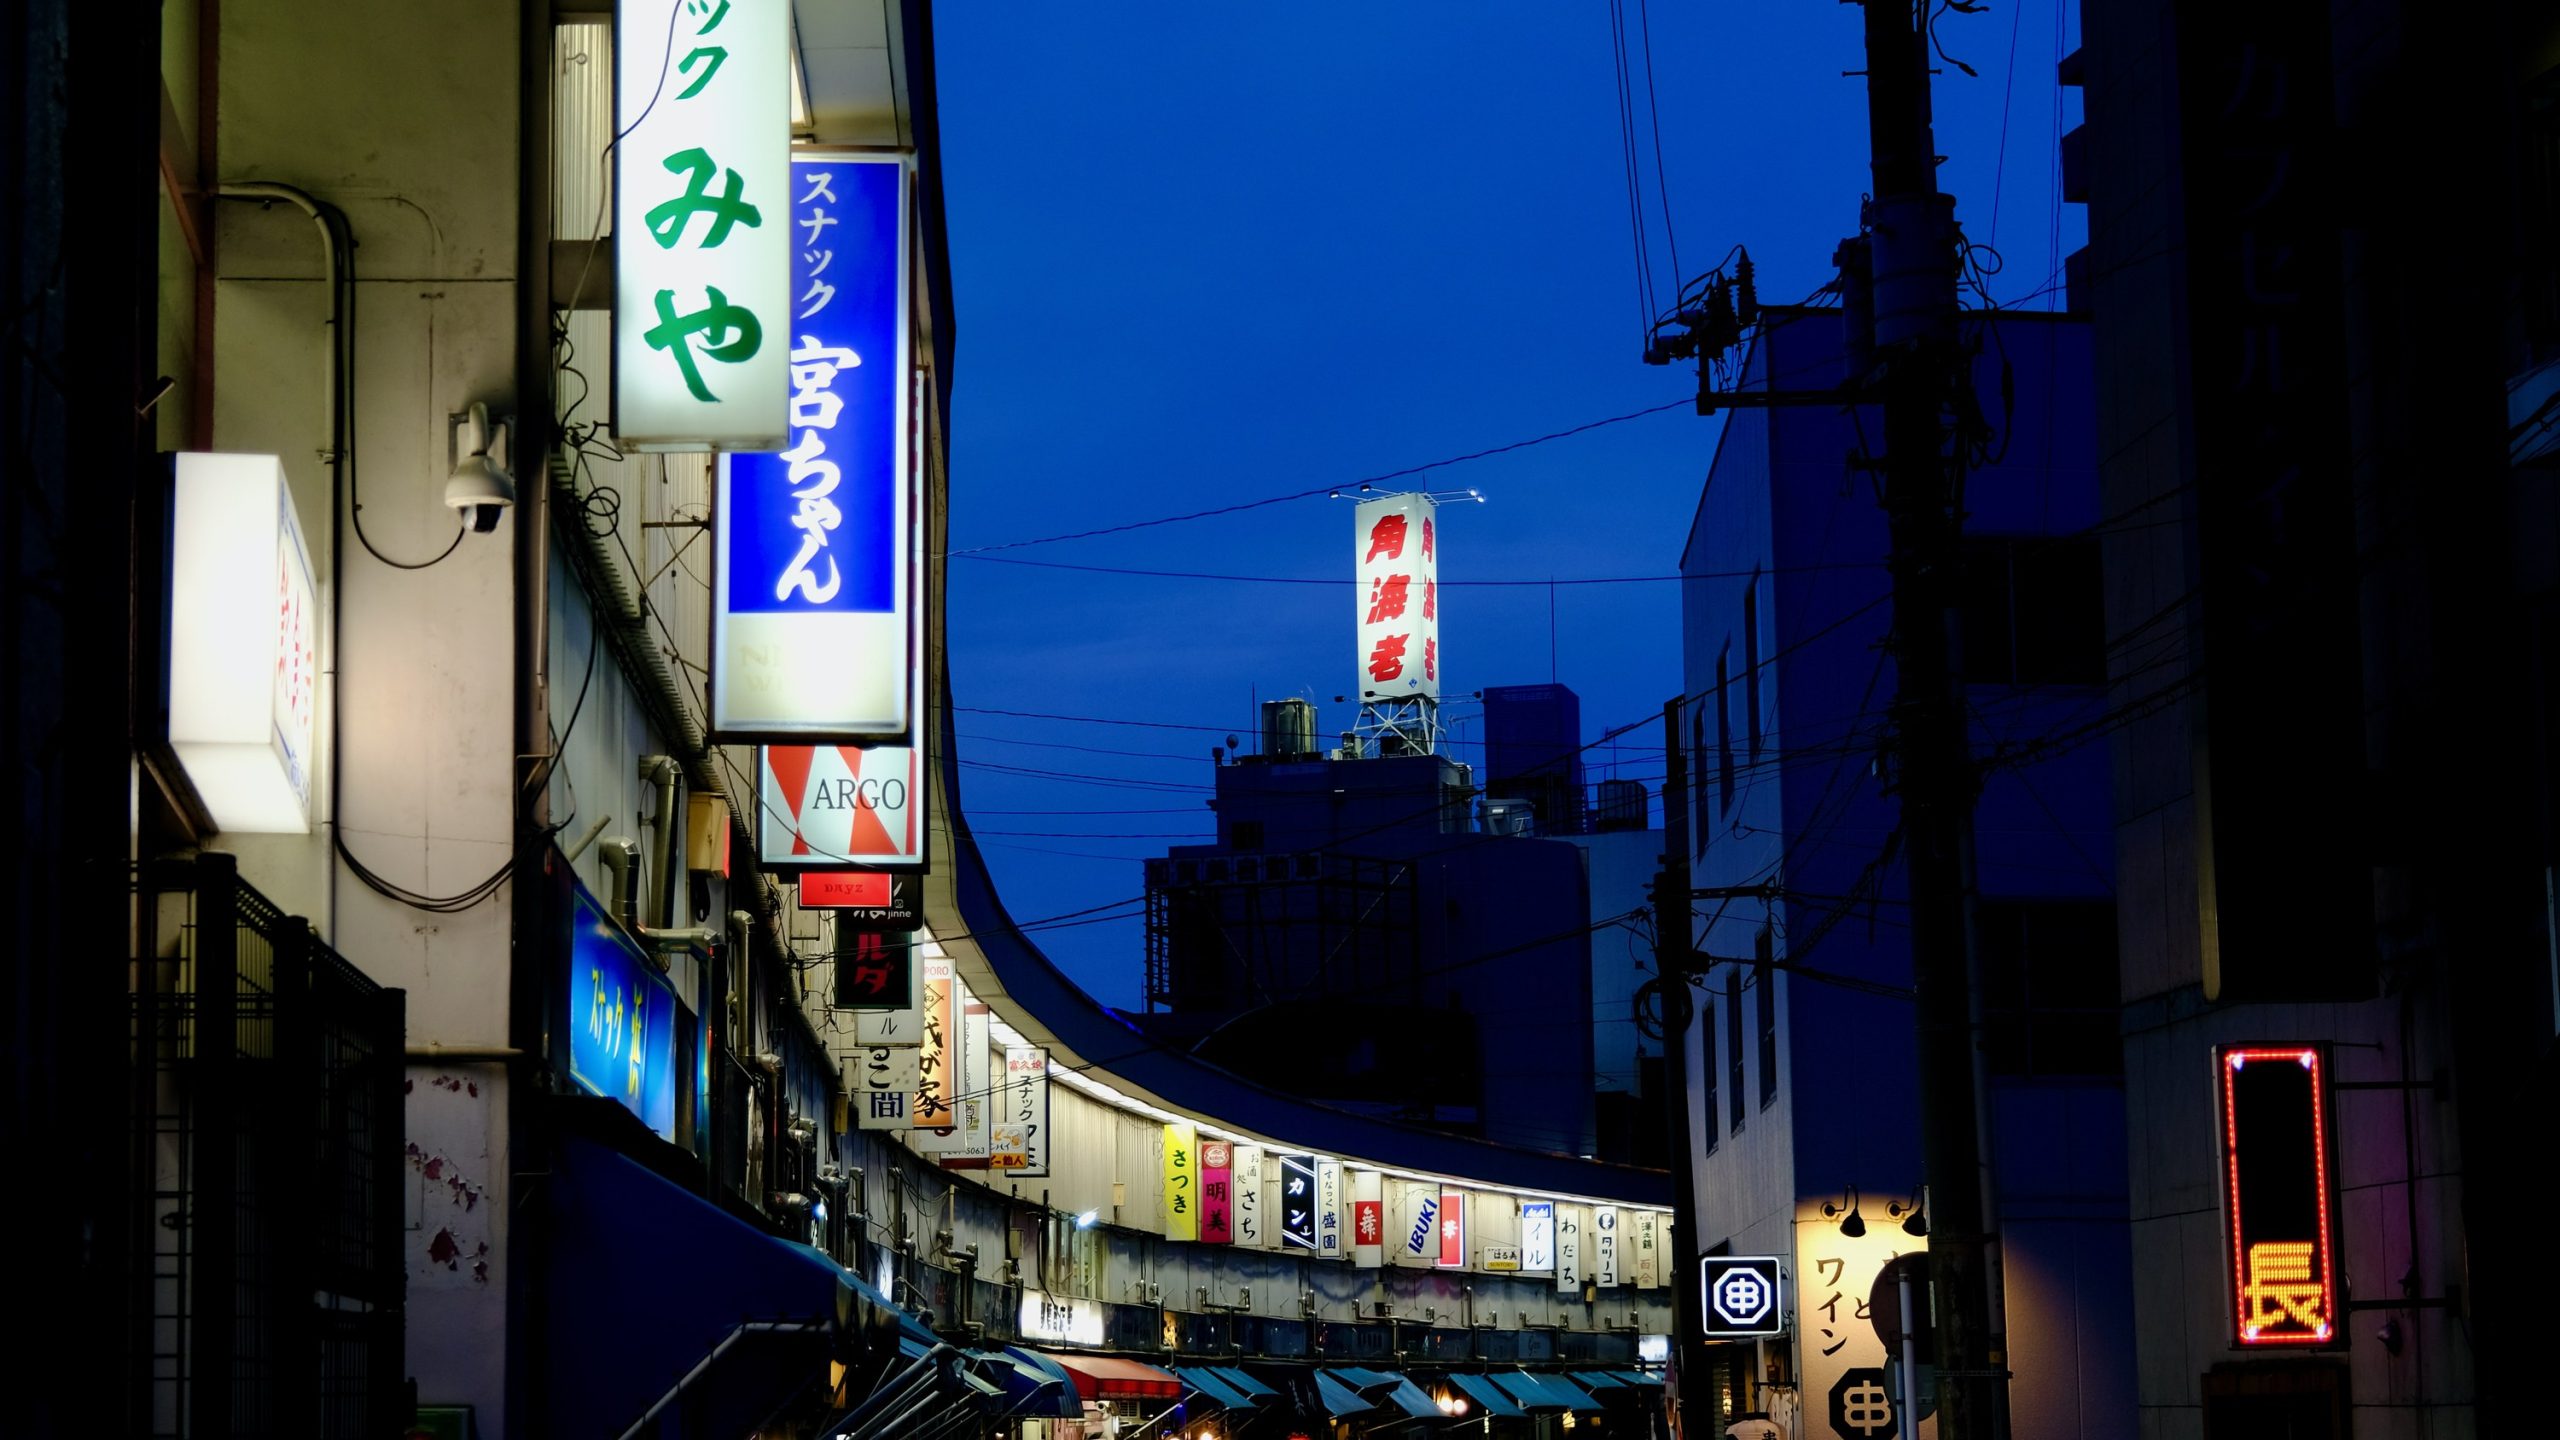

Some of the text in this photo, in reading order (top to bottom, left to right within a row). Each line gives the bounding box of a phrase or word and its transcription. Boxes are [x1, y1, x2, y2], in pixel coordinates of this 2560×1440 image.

[643, 146, 763, 403] みや
[799, 172, 839, 320] スナック
[776, 335, 862, 604] 宮ちゃん
[1366, 514, 1411, 682] 角海老
[812, 778, 906, 810] ARGO
[887, 910, 912, 920] jinne
[1018, 1075, 1034, 1122] スナック
[1171, 1150, 1188, 1214] さつき
[1206, 1181, 1226, 1232] 明美
[1288, 1177, 1306, 1225] カン
[1241, 1189, 1256, 1240] さち
[1408, 1197, 1438, 1254] IBUKI
[1561, 1217, 1577, 1285] わだち
[1815, 1257, 1848, 1357] ワイン
